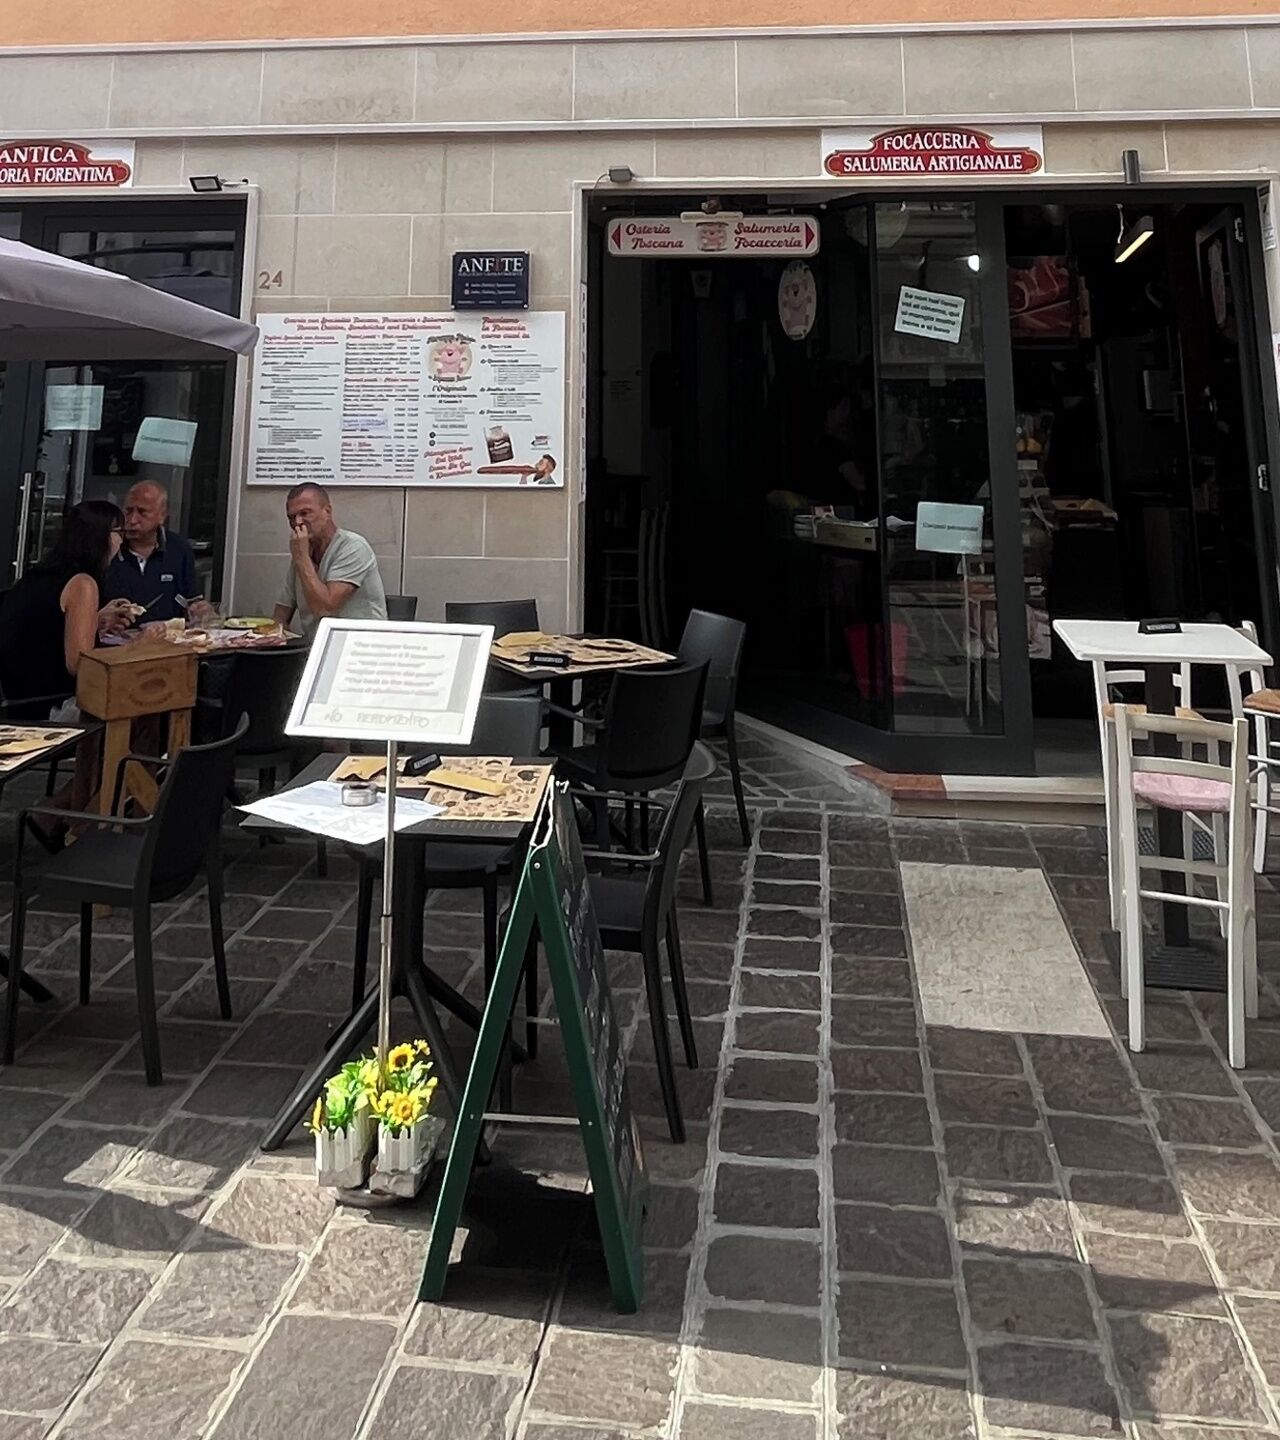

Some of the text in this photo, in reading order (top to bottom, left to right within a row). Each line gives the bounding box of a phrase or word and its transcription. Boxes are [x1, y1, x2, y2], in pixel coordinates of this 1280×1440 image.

[883, 132, 980, 150] FOCACCERIA
[843, 154, 1023, 172] SALUMERIA ARTIGIANALE
[33, 166, 115, 183] FIORENTINA
[625, 223, 671, 236] Osteria
[734, 222, 801, 236] Salumeria
[631, 237, 685, 250] Toscana
[734, 236, 804, 250] Focacceria
[258, 269, 283, 289] 24
